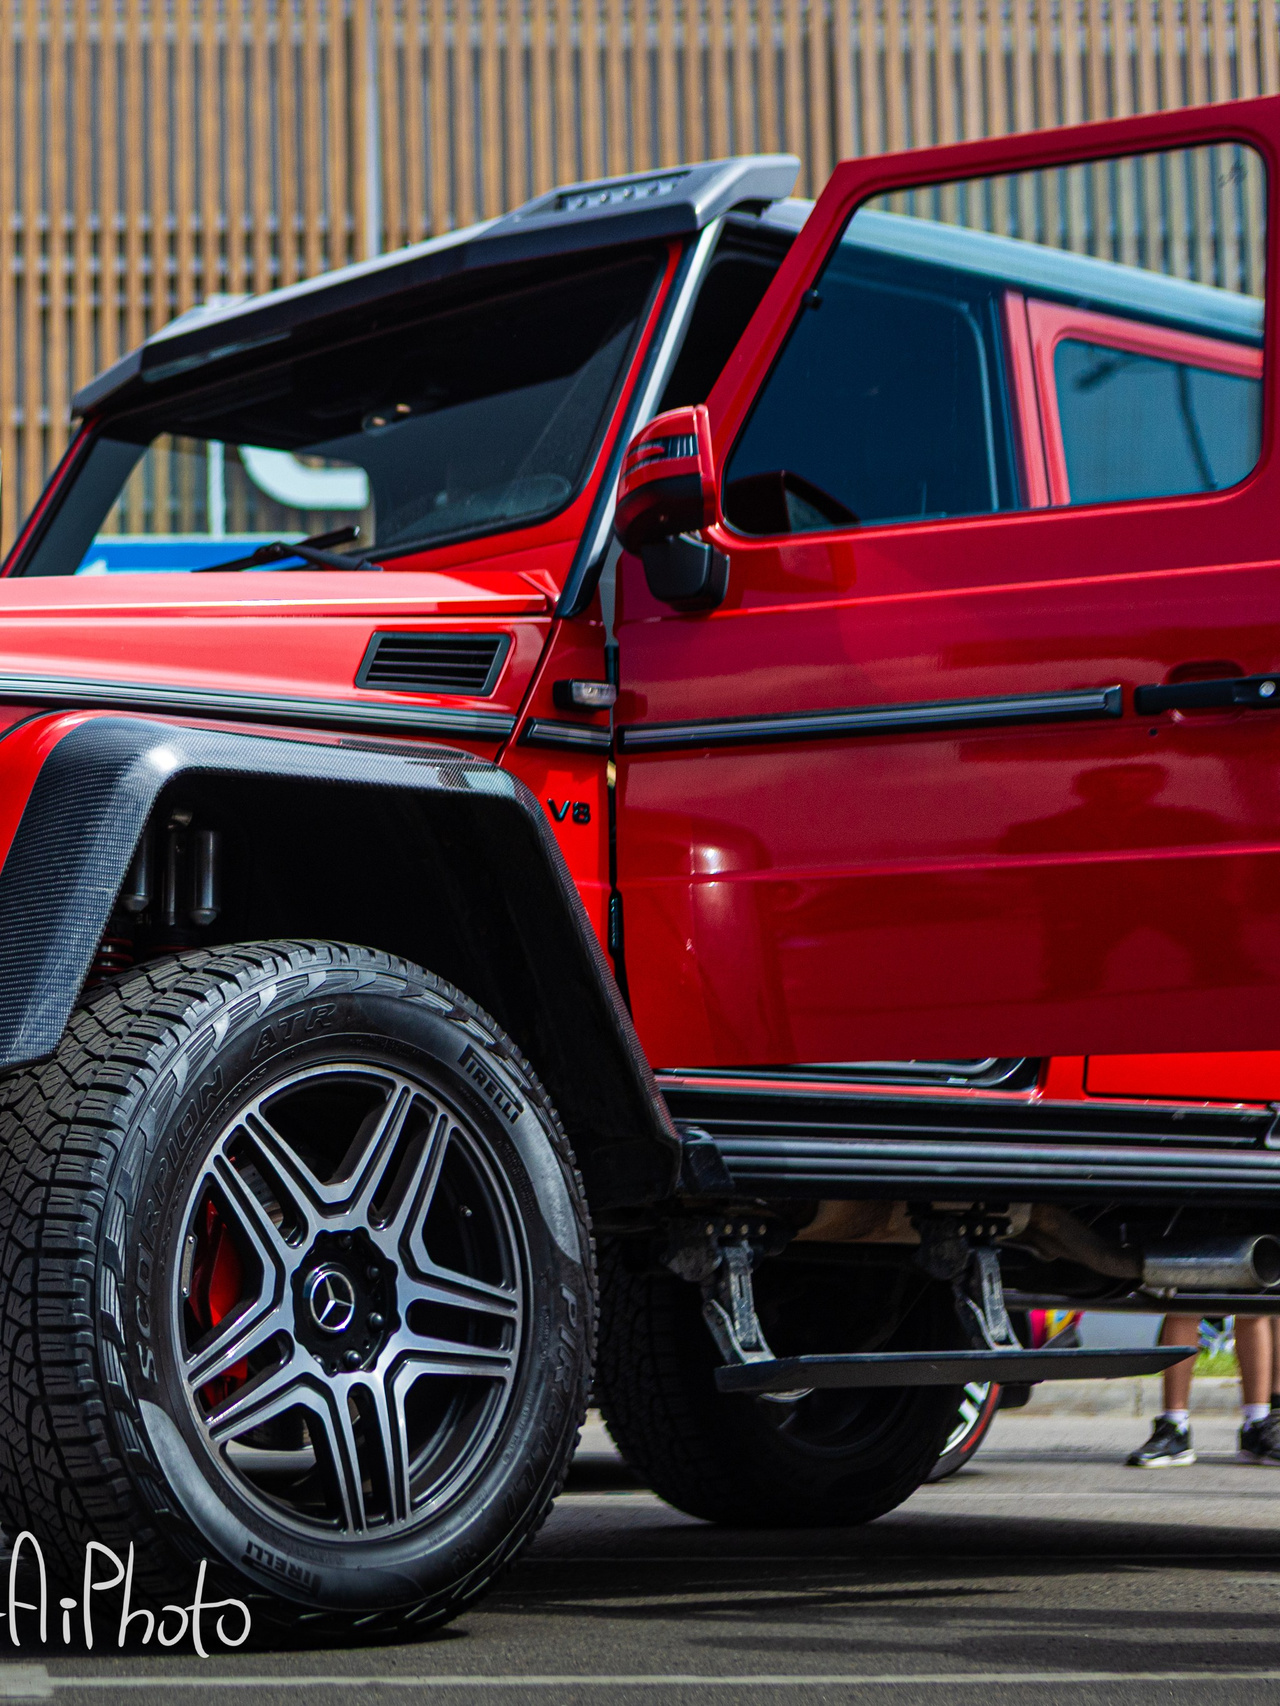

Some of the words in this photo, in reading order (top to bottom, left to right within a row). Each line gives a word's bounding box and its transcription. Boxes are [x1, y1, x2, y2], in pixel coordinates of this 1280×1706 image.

[547, 797, 591, 825] V8
[457, 1043, 524, 1124] PIRELLI
[135, 1063, 225, 1386] SCORPION
[250, 1002, 337, 1062] ATR
[241, 1539, 322, 1598] PIRELLI
